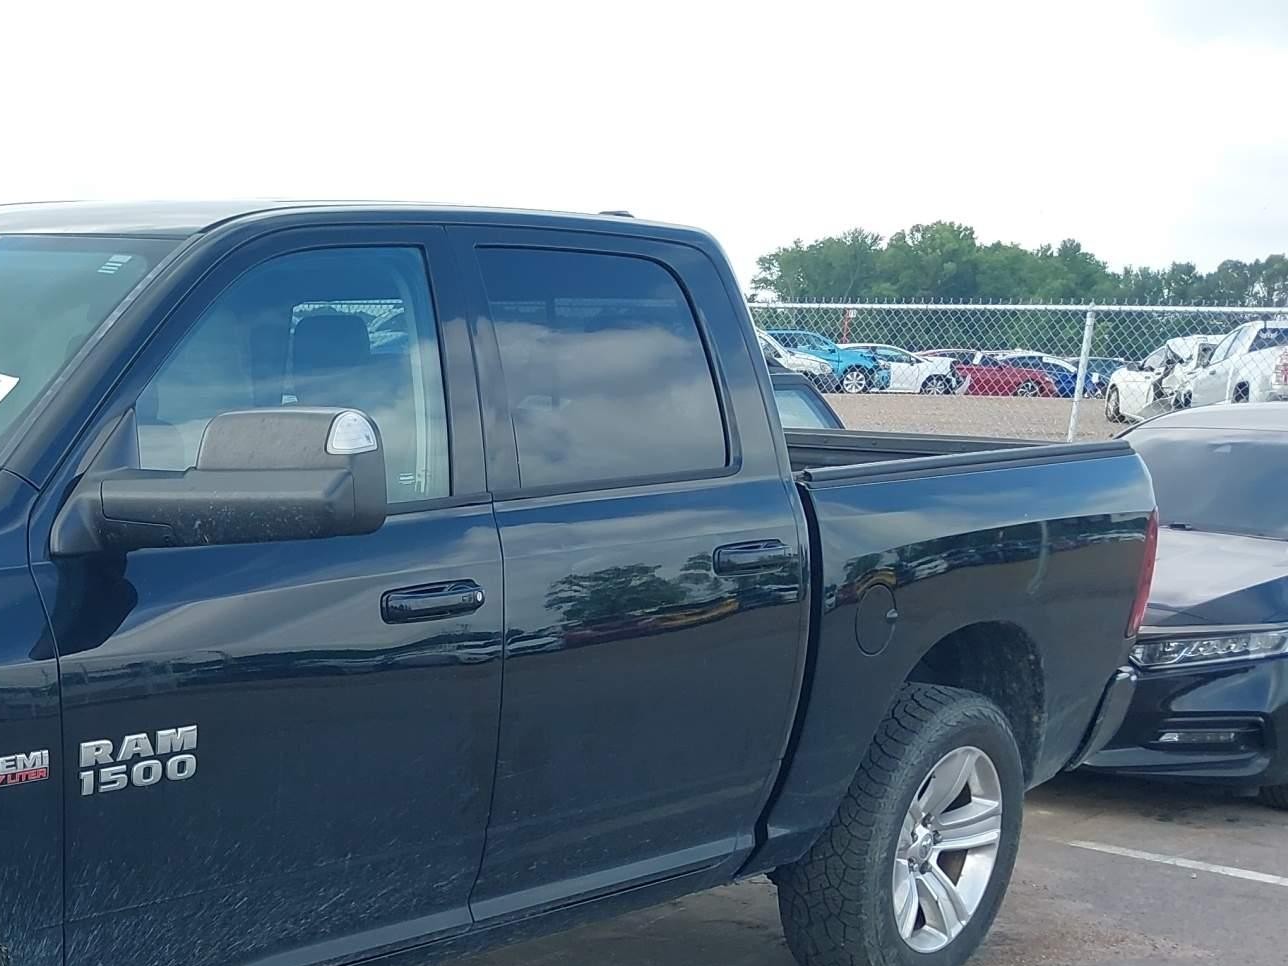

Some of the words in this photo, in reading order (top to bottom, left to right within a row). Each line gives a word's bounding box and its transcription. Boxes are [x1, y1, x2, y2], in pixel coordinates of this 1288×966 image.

[80, 725, 198, 767] RAM
[6, 767, 48, 785] LITER
[80, 754, 197, 796] 1500
